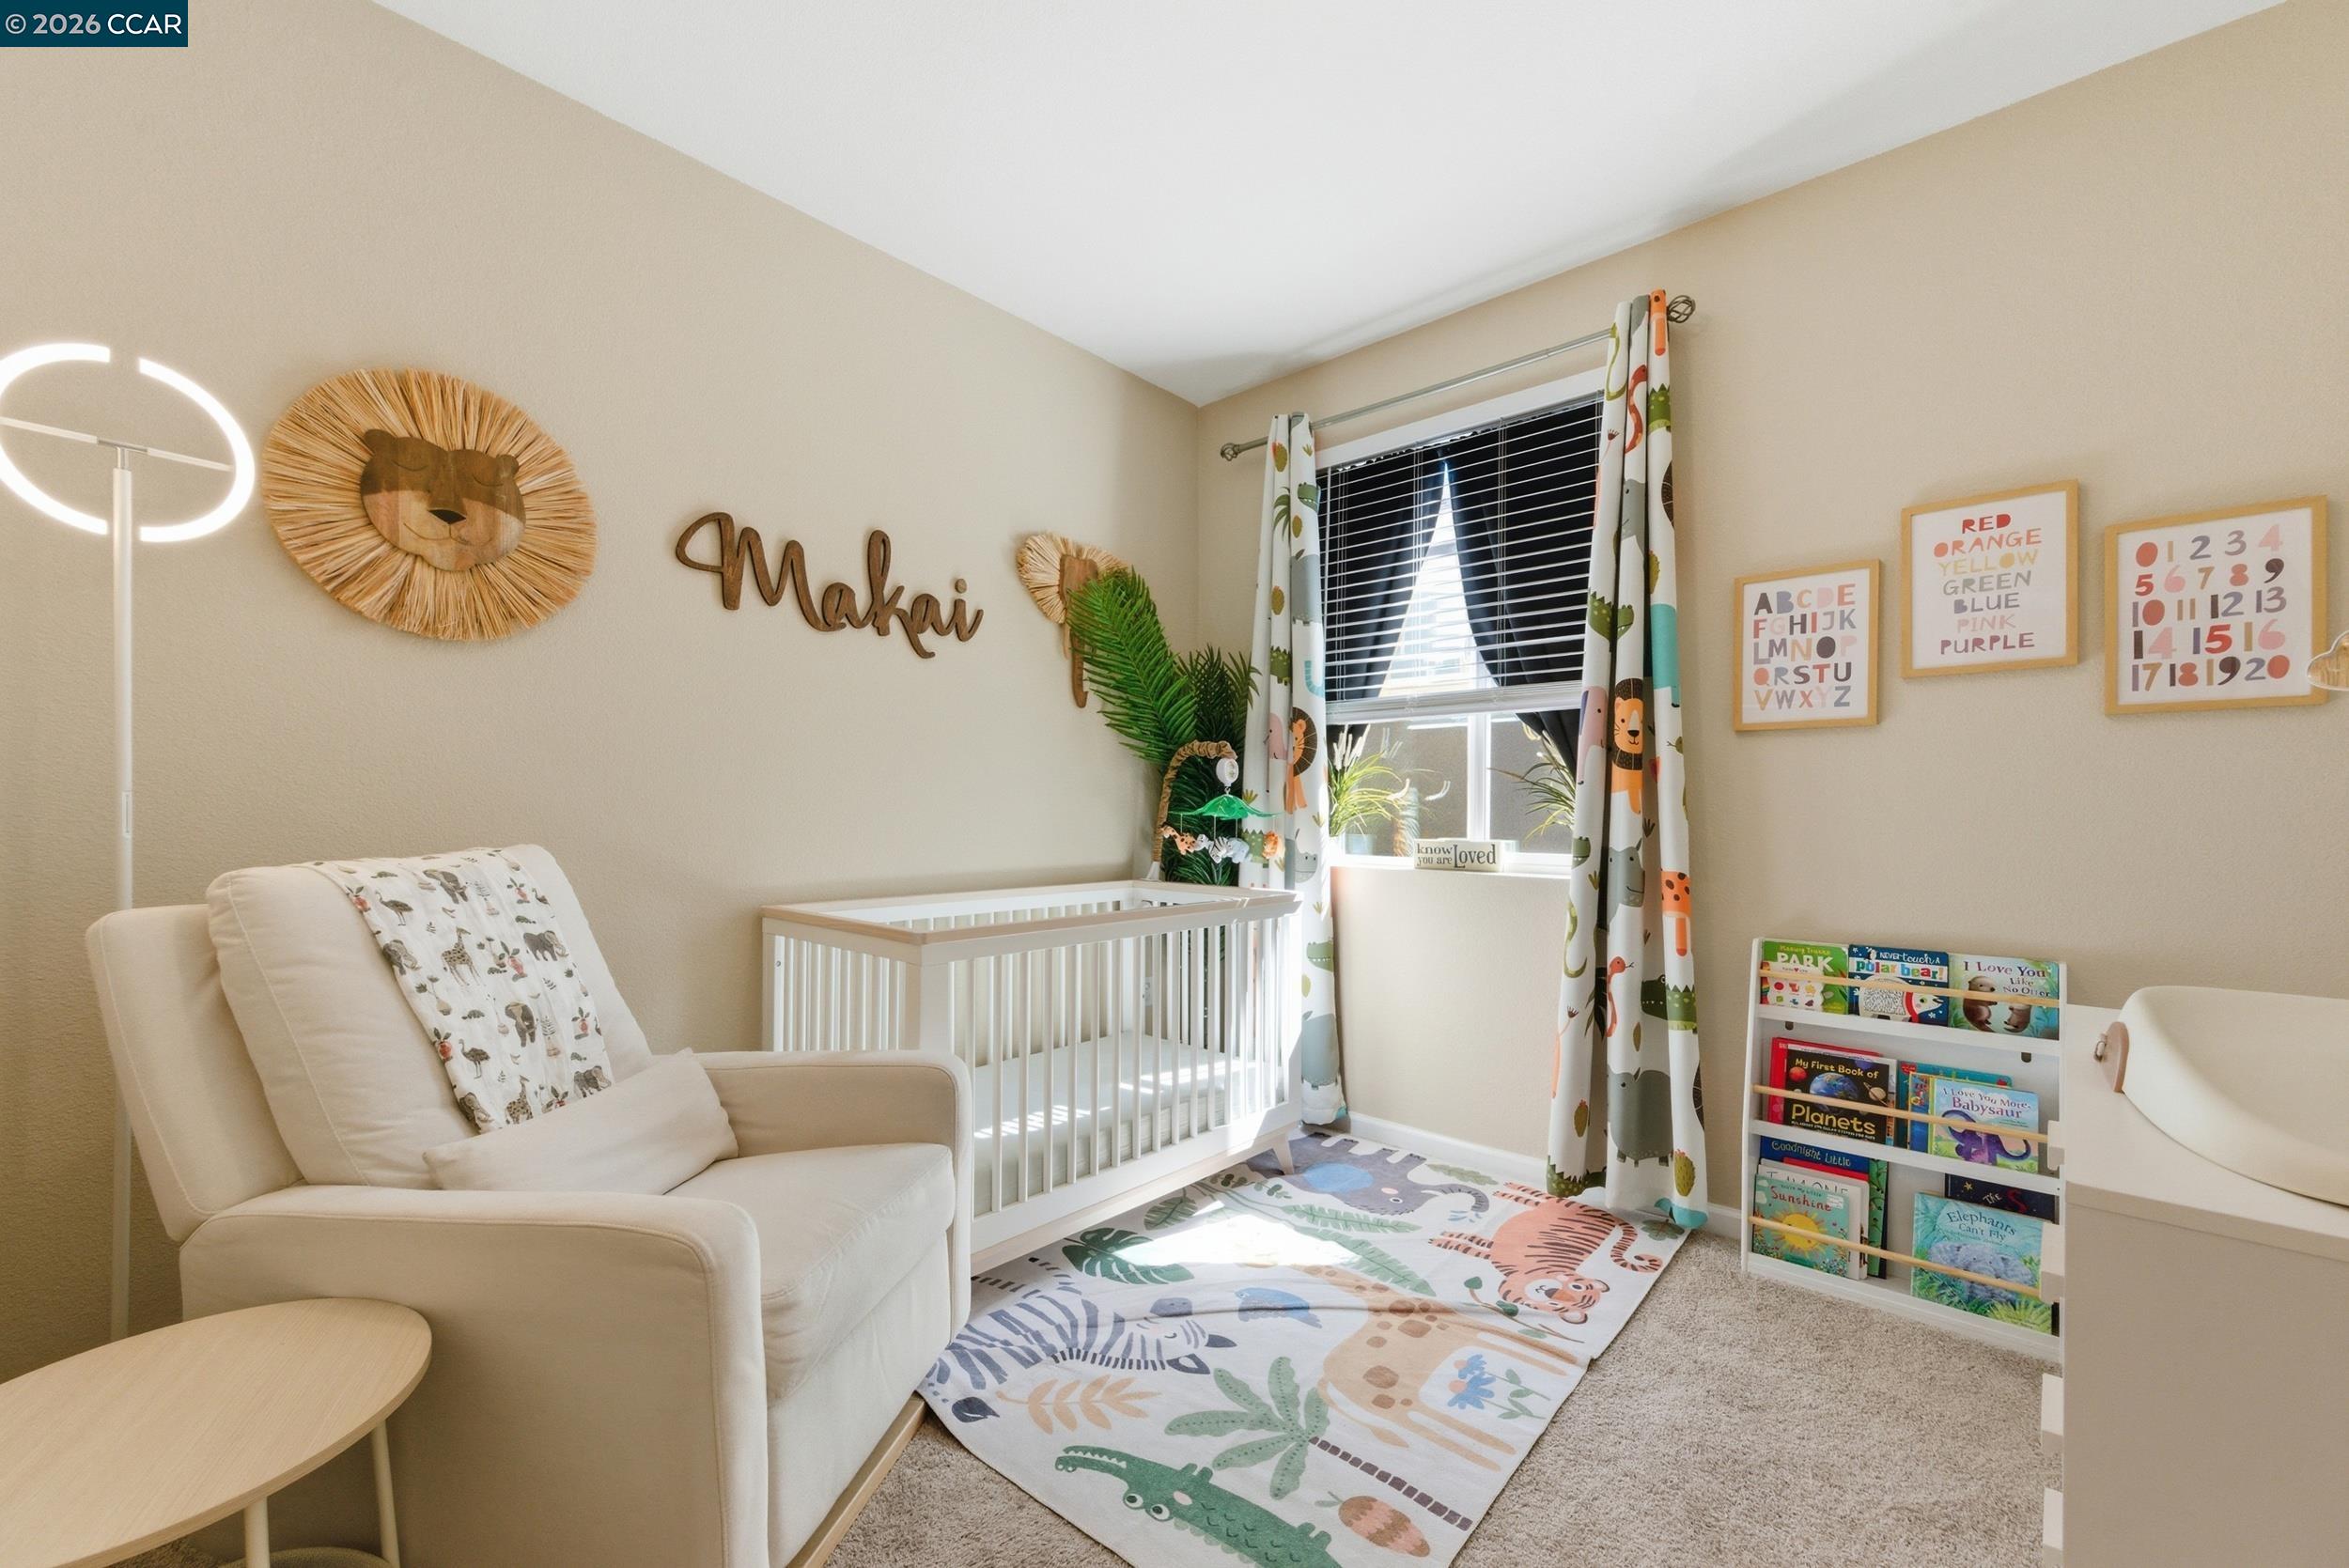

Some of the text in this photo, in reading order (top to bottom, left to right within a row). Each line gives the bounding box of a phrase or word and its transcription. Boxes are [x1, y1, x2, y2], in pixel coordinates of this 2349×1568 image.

[1962, 514, 2011, 534] RED
[1934, 528, 2042, 557] ORANGE
[2189, 536, 2212, 560] 2
[2224, 530, 2247, 556] 3
[2258, 523, 2283, 551] 4
[1938, 549, 2038, 576] YELLOW
[676, 512, 984, 659] Makai
[1943, 570, 2031, 596] GREEN
[2135, 558, 2284, 597] 5 6 7 8 9
[1954, 592, 2020, 613] BLUE
[2132, 586, 2287, 628] 10 11 12 13
[1956, 613, 2016, 633] PINK
[1940, 632, 2034, 655] PURPLE
[2134, 618, 2286, 660] 14 15 16
[2132, 655, 2290, 691] 17 18 19 20
[1417, 844, 1453, 854] know
[1453, 844, 1496, 868] Loved
[1417, 857, 1433, 866] you
[1777, 952, 1834, 972] PARK
[1901, 964, 1944, 980] bear!
[1964, 961, 2046, 977] I Love You
[2010, 978, 2033, 986] Like
[1796, 1058, 1808, 1067] My
[1812, 1061, 1835, 1071] First
[1838, 1065, 1864, 1077] Book
[1951, 1088, 1974, 1097] Love
[1979, 1094, 1997, 1105] You
[1999, 1099, 2031, 1109] More,
[1952, 1097, 2022, 1119] Babysaur
[1792, 1104, 1875, 1135] Planets
[1771, 1141, 1851, 1166] Goodnight Little
[1770, 1186, 1832, 1211] Sunshine
[1947, 1210, 2016, 1236] Elephants
[1958, 1223, 1984, 1235] Can't
[1989, 1231, 2006, 1242] Fly
